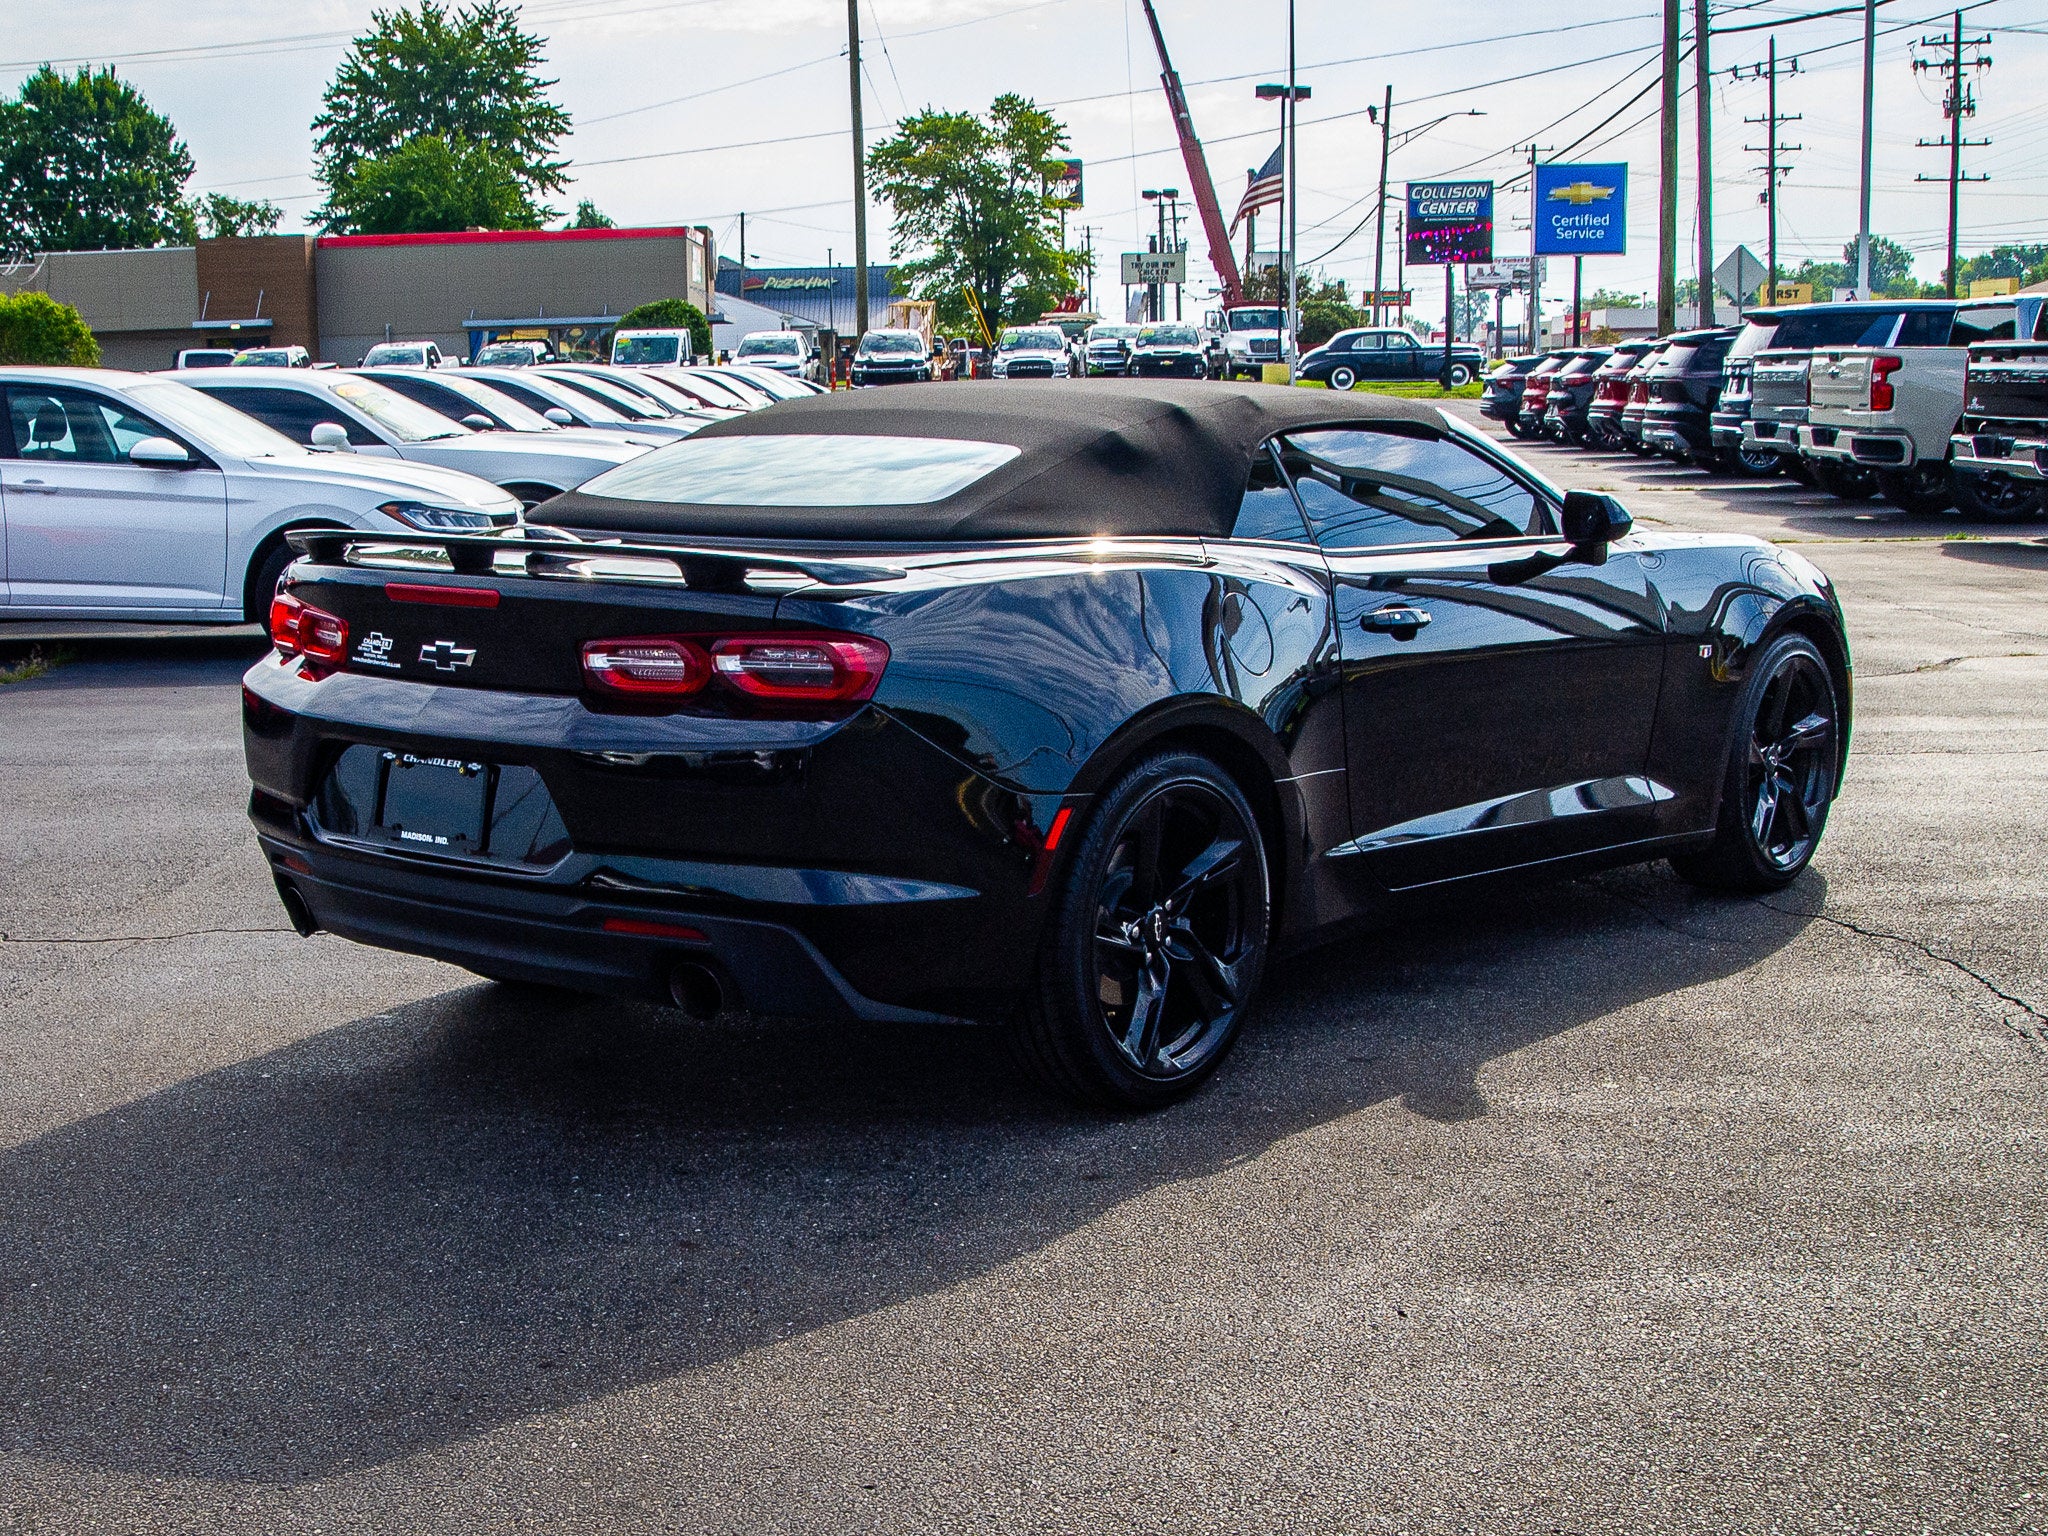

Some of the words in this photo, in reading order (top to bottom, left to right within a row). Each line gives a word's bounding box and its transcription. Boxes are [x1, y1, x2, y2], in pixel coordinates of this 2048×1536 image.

[1411, 186, 1488, 200] COLLISION
[1419, 200, 1478, 215] CENTER
[1551, 213, 1610, 227] Certified
[1556, 227, 1605, 239] Service
[1138, 268, 1169, 276] CHICKEN
[763, 276, 805, 290] Pizza
[1766, 289, 1800, 299] RST
[403, 753, 462, 768] CHANDLER
